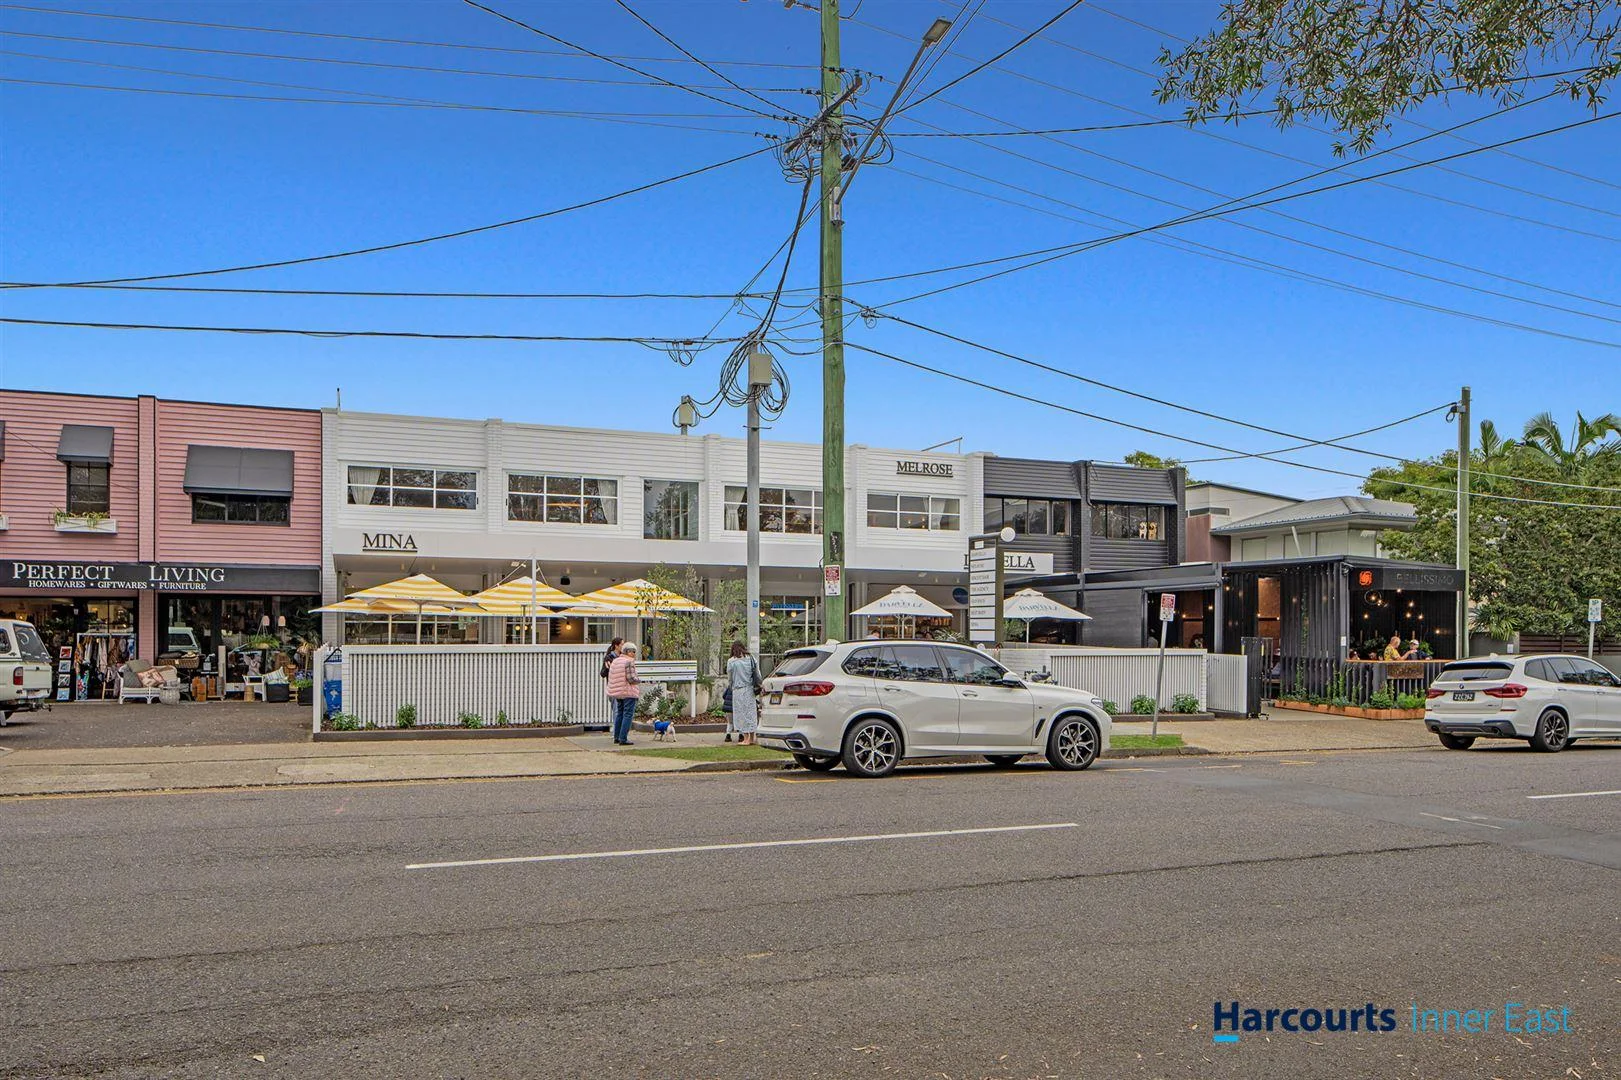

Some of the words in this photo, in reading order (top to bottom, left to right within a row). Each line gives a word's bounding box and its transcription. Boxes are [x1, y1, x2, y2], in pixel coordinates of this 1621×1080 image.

[896, 461, 953, 475] MELROSE
[362, 532, 418, 549] MINA
[12, 562, 114, 580] PERFECT
[149, 565, 225, 582] LIVING
[29, 580, 86, 588] HOMEWARES
[97, 581, 147, 589] GIFTWARES
[159, 582, 207, 590] FURNITURE
